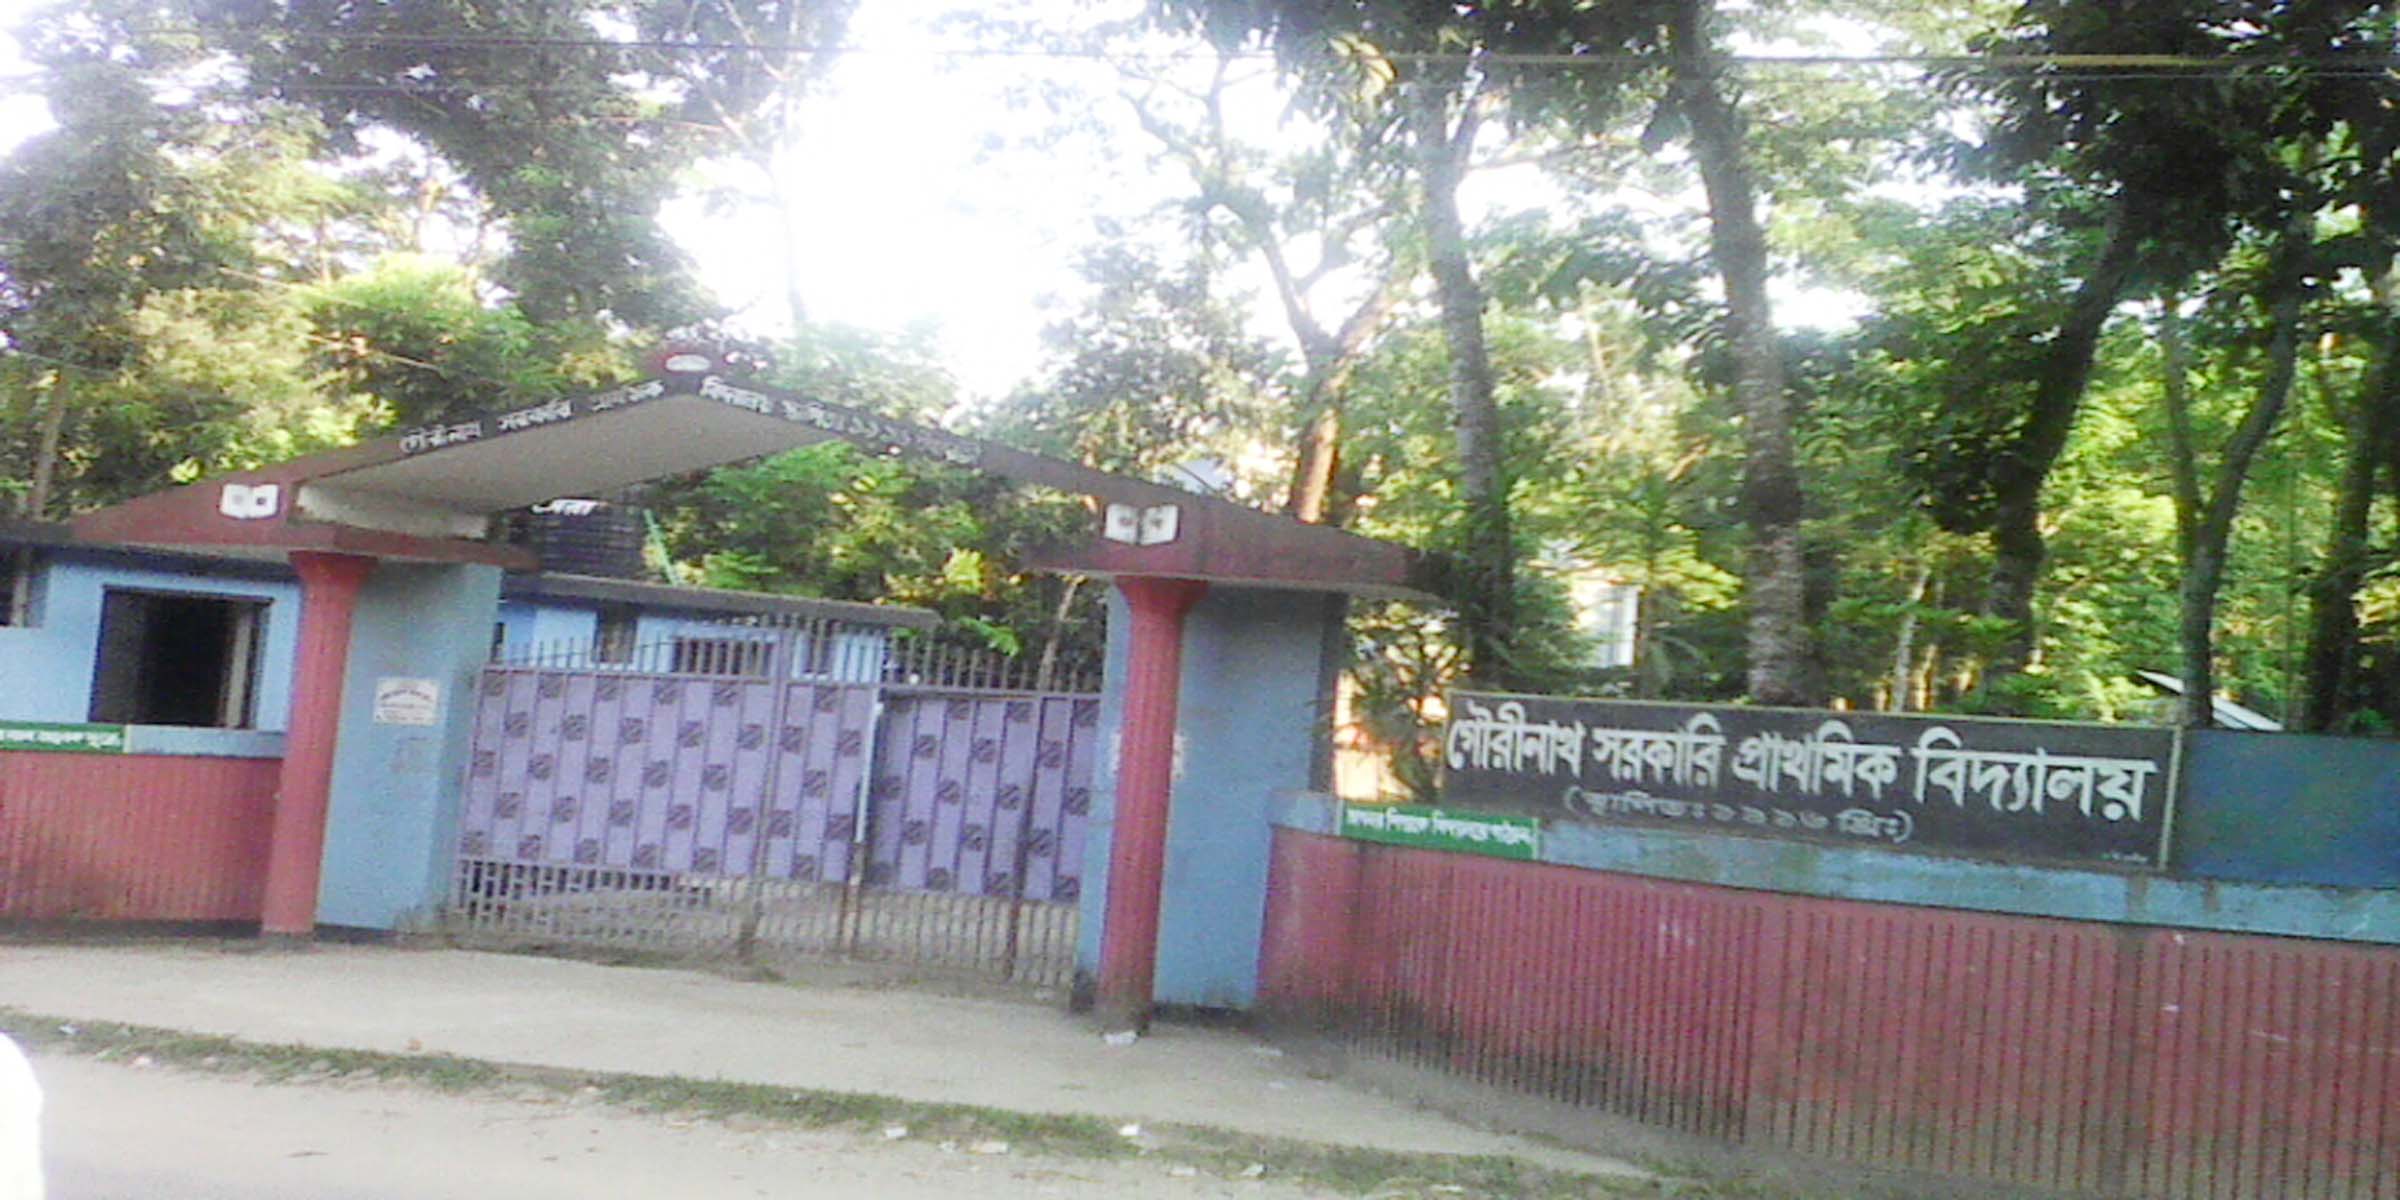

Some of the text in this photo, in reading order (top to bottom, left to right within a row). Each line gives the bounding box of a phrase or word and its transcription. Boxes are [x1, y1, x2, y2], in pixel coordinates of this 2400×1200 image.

[1448, 698, 2160, 823] গৌরীনাথ সরকারি প্রাথমিক বিদ্যালয়
